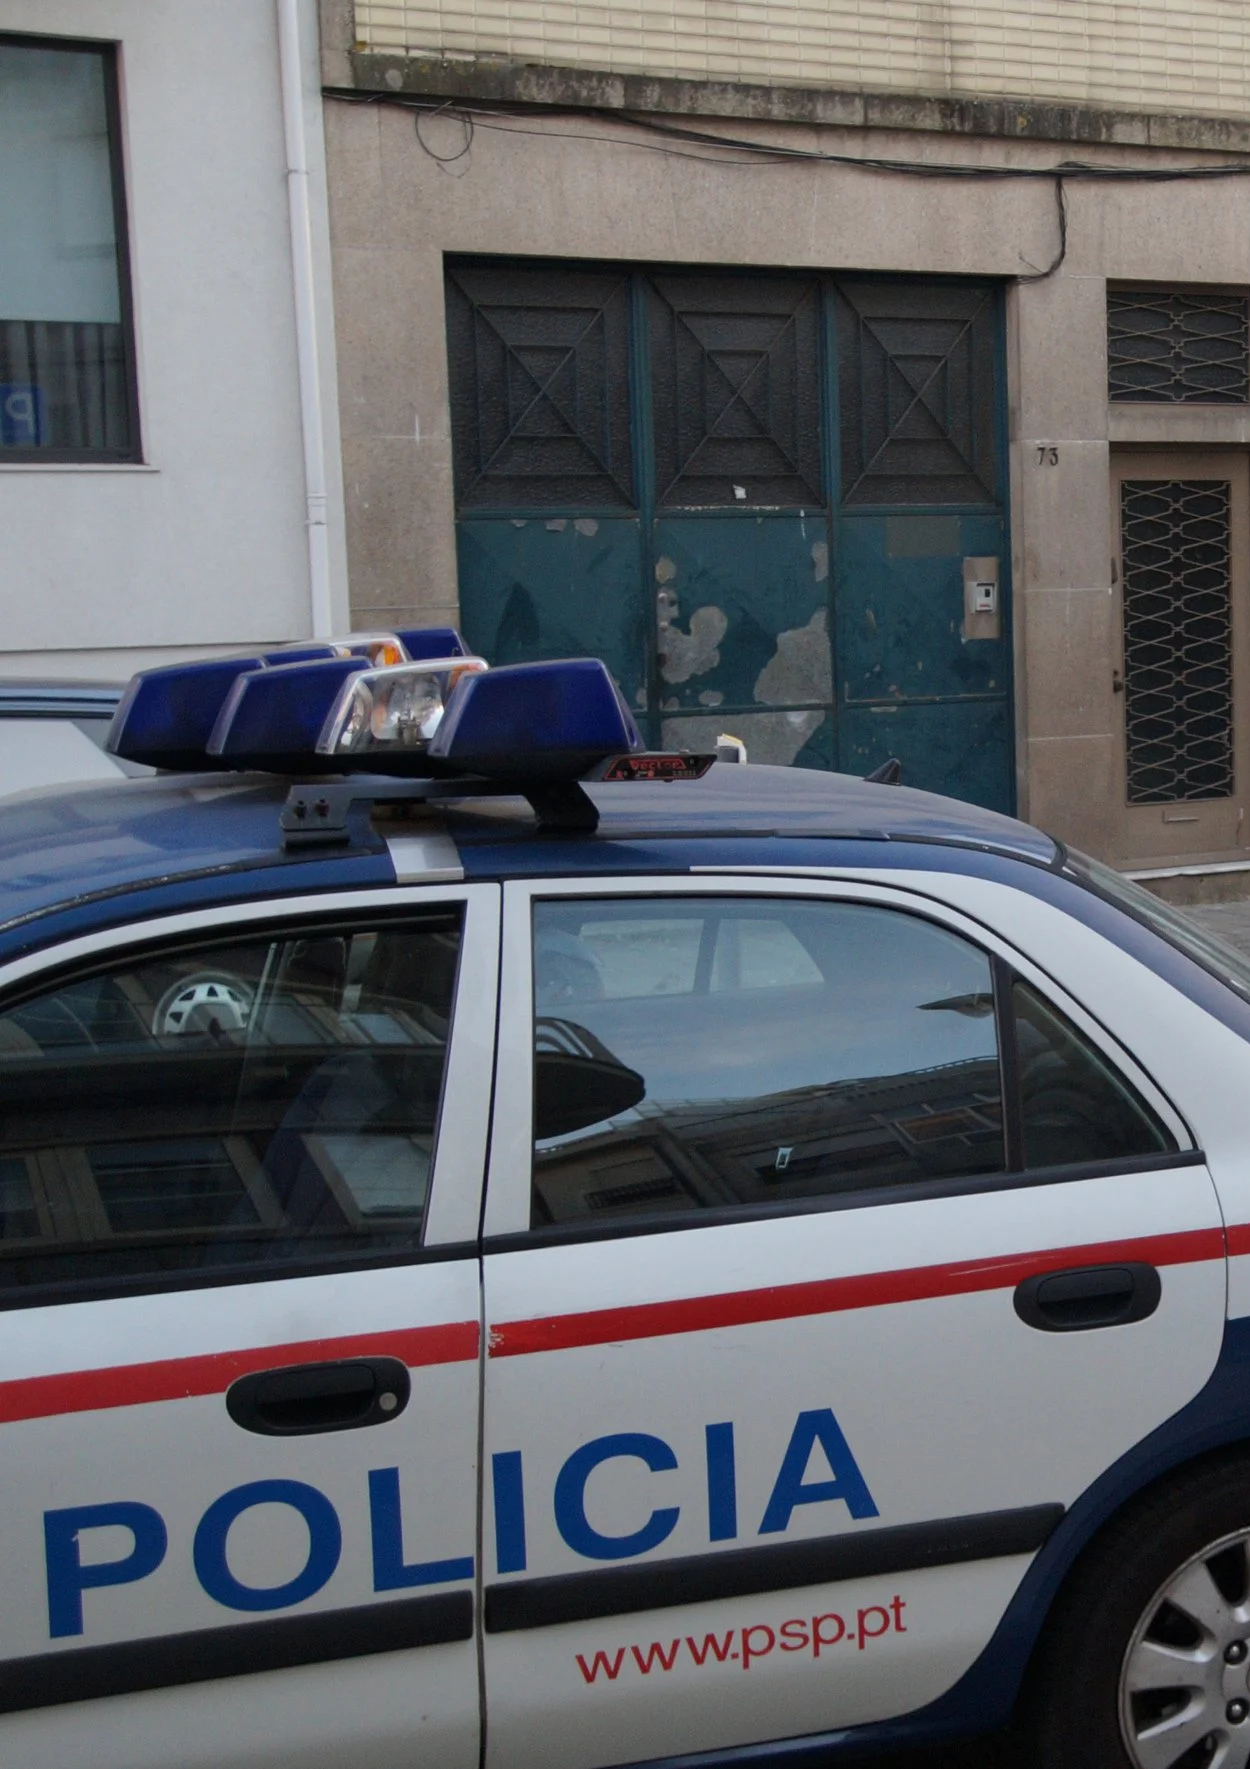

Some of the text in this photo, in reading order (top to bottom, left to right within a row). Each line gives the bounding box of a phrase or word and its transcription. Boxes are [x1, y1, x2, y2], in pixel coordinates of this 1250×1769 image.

[1036, 446, 1059, 467] 73
[43, 1407, 880, 1640] POLICIA
[575, 1595, 908, 1685] www.psp.pt
